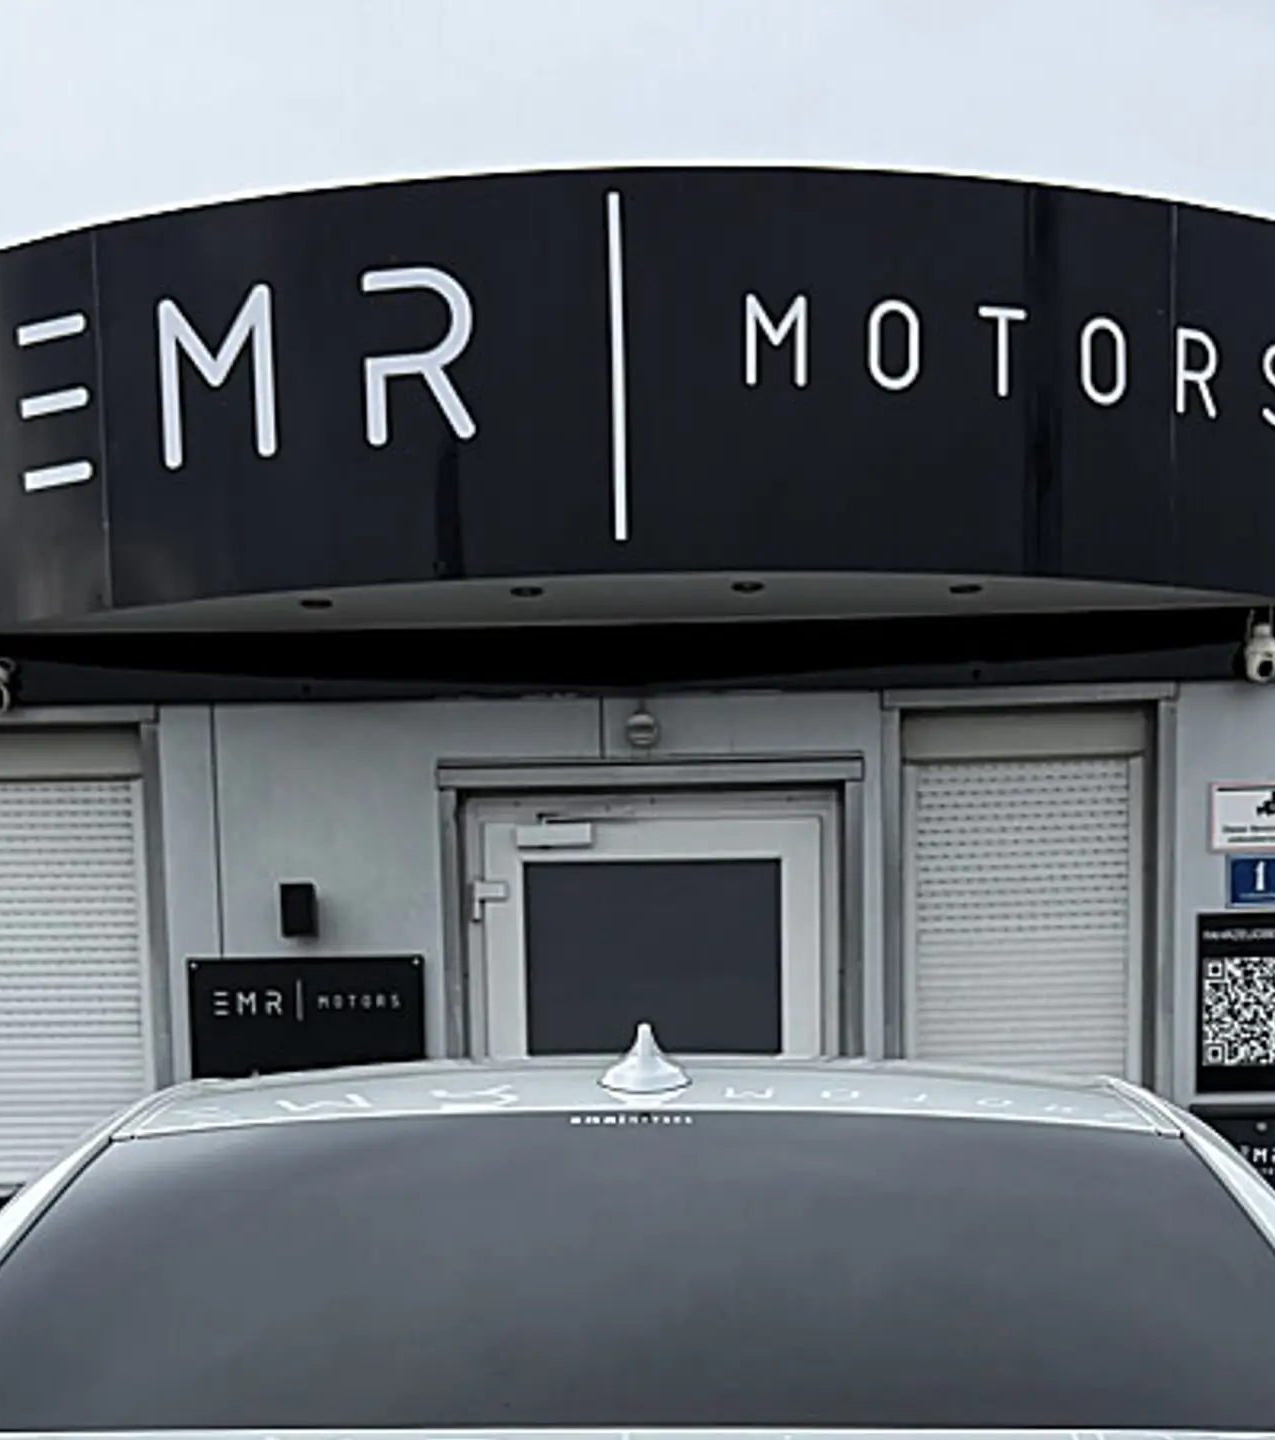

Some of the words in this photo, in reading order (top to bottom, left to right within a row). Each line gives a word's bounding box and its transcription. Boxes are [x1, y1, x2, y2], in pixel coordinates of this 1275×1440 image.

[17, 267, 476, 491] EMR
[1255, 860, 1266, 892] 1
[212, 990, 283, 1016] EMR
[317, 994, 401, 1010] MOTORS
